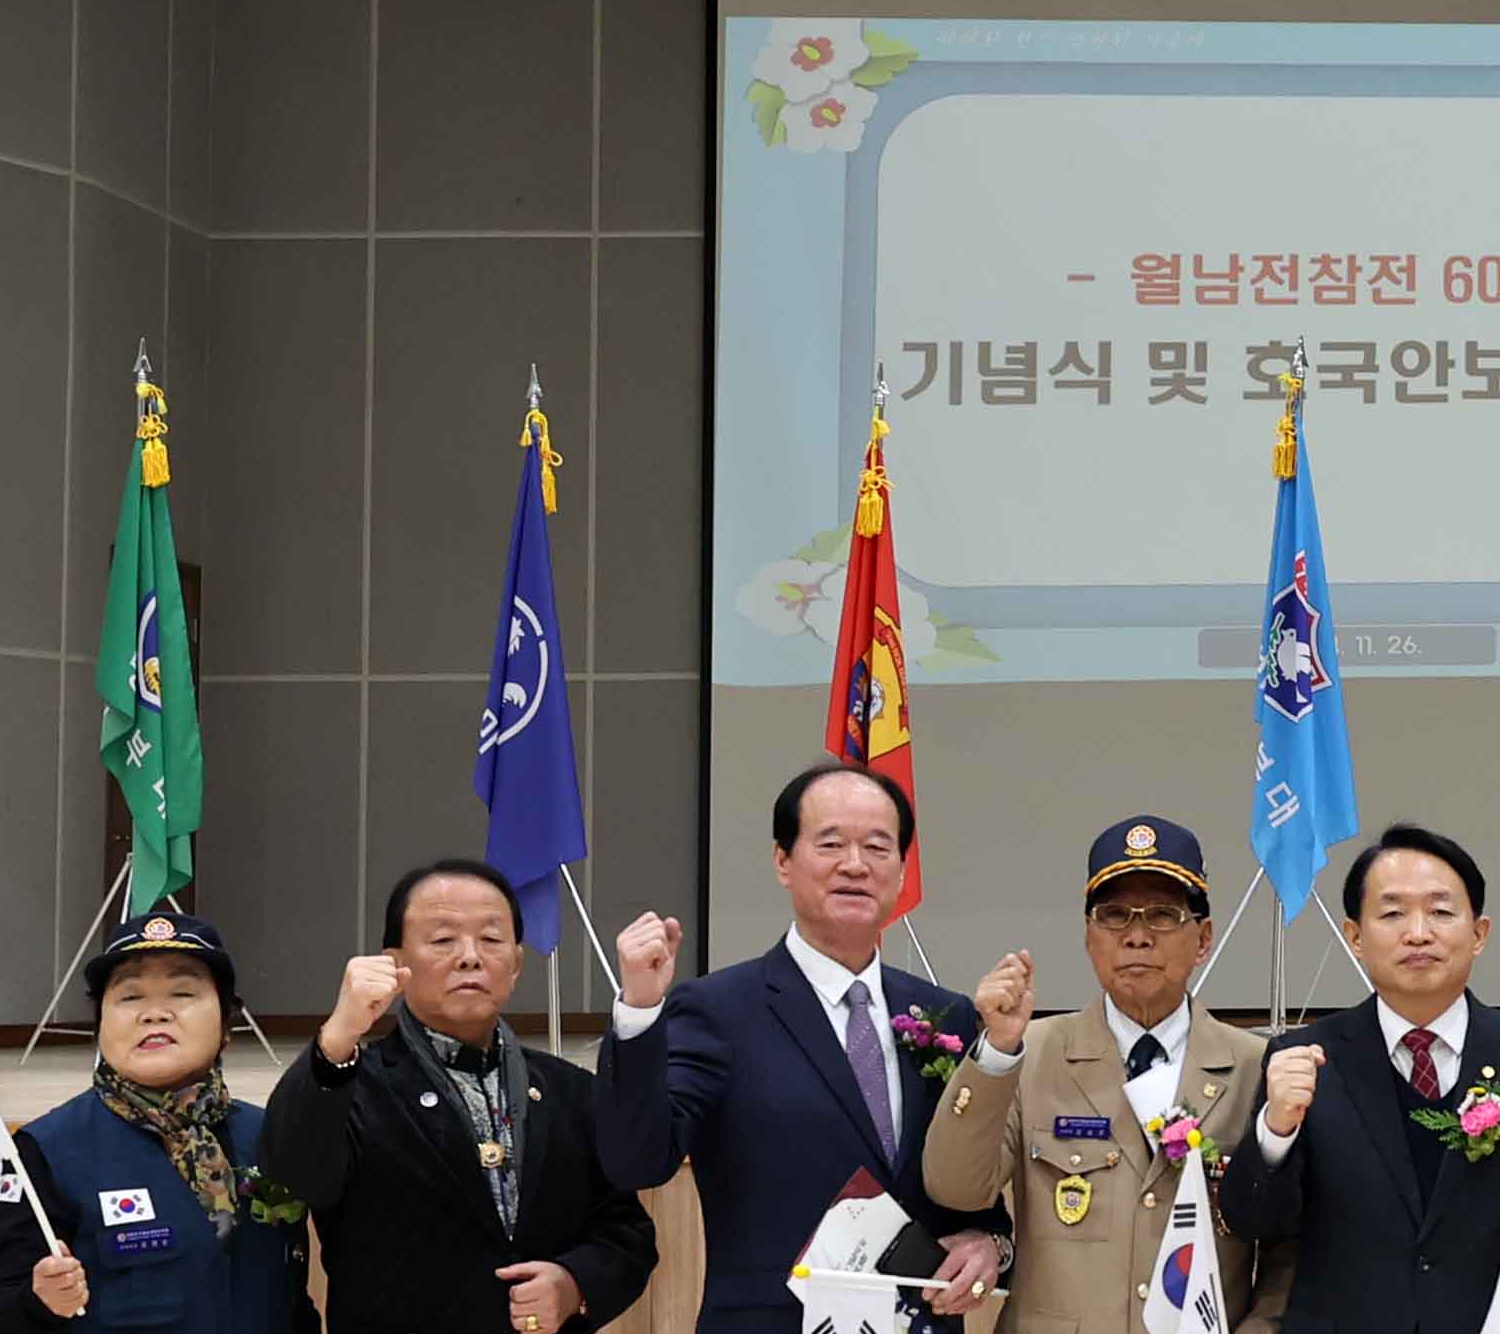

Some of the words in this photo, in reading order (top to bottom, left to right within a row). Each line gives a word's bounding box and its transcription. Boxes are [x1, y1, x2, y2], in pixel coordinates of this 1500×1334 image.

[1130, 250, 1419, 309] 월남전참전
[900, 339, 1112, 406] 기념식
[1147, 340, 1209, 406] 및
[1354, 635, 1377, 656] 11.
[1387, 634, 1423, 656] 26.
